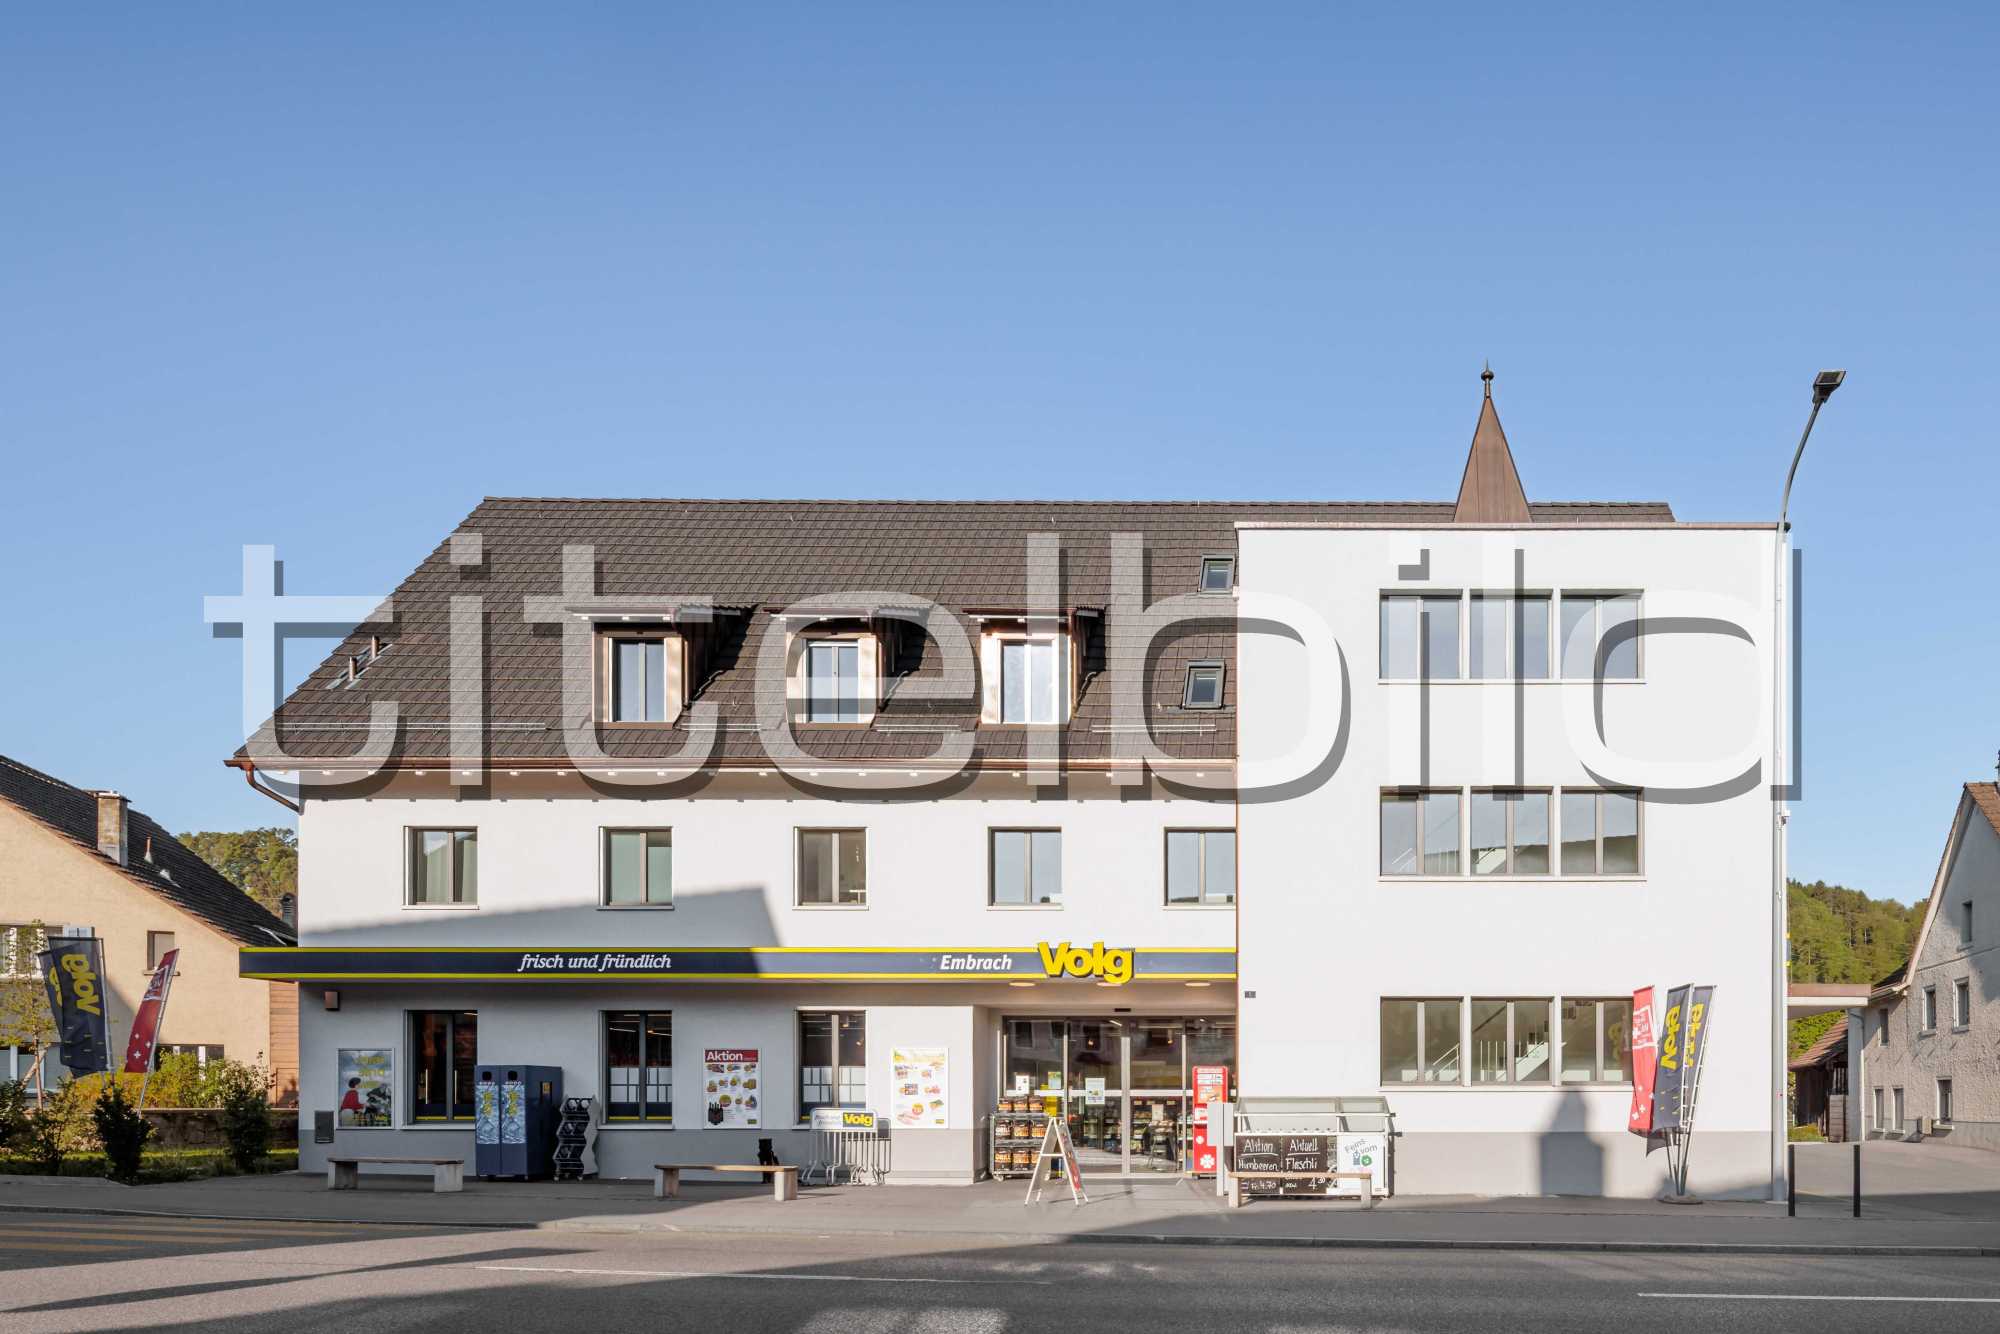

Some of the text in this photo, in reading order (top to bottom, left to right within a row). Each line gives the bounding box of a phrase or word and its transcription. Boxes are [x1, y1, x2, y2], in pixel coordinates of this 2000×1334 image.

[517, 953, 671, 972] frisch und fründlich
[939, 954, 1013, 970] Embrach
[1037, 941, 1135, 985] Volg
[706, 1050, 744, 1061] Aktion
[844, 1112, 873, 1127] Volg
